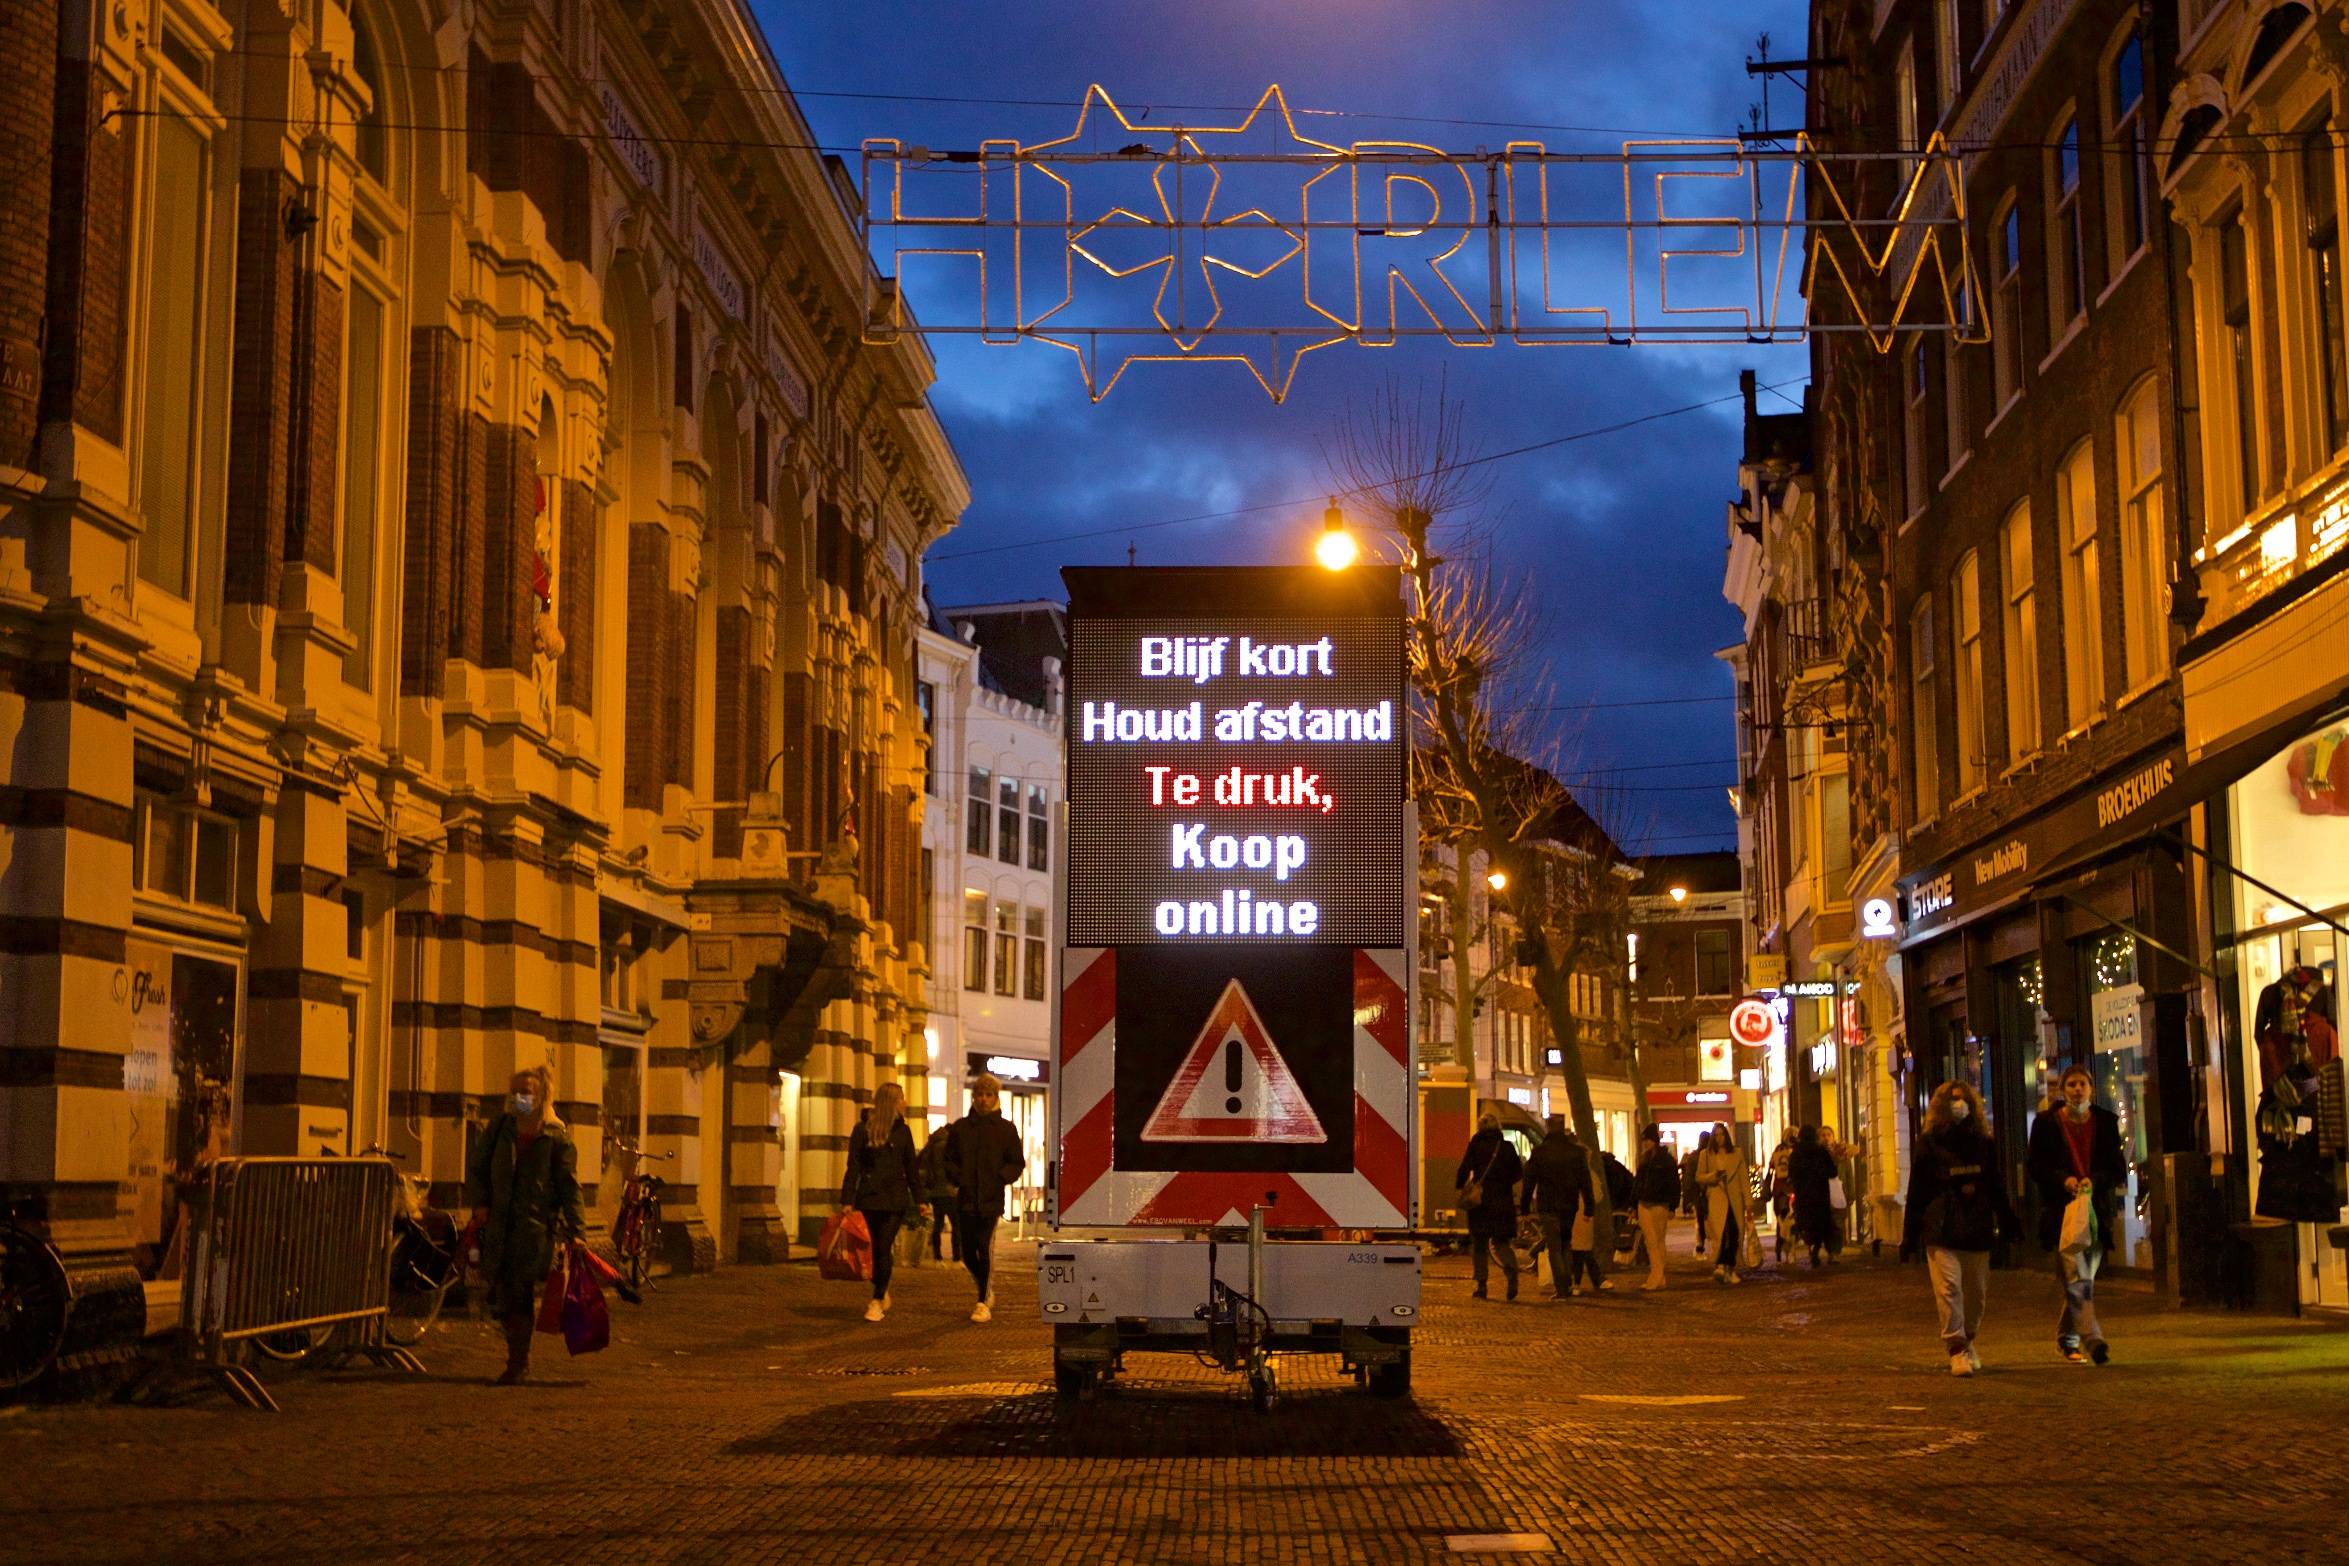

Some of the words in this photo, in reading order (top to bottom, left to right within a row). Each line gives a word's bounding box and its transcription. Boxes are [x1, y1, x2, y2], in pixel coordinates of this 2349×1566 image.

[1141, 637, 1229, 684] Blijf
[1239, 637, 1332, 676] kort
[1083, 701, 1201, 741] Houd
[1215, 701, 1391, 741] afstand
[1145, 767, 1199, 806] Te
[1215, 767, 1332, 813] druk,
[2098, 759, 2173, 828] BROEKHUIS
[1172, 823, 1305, 880] Koop
[1975, 858, 1994, 885] New
[1993, 840, 2027, 877] Mobility
[1155, 890, 1317, 934] online
[1048, 1266, 1074, 1283] SPL1
[1348, 1253, 1377, 1264] A339
